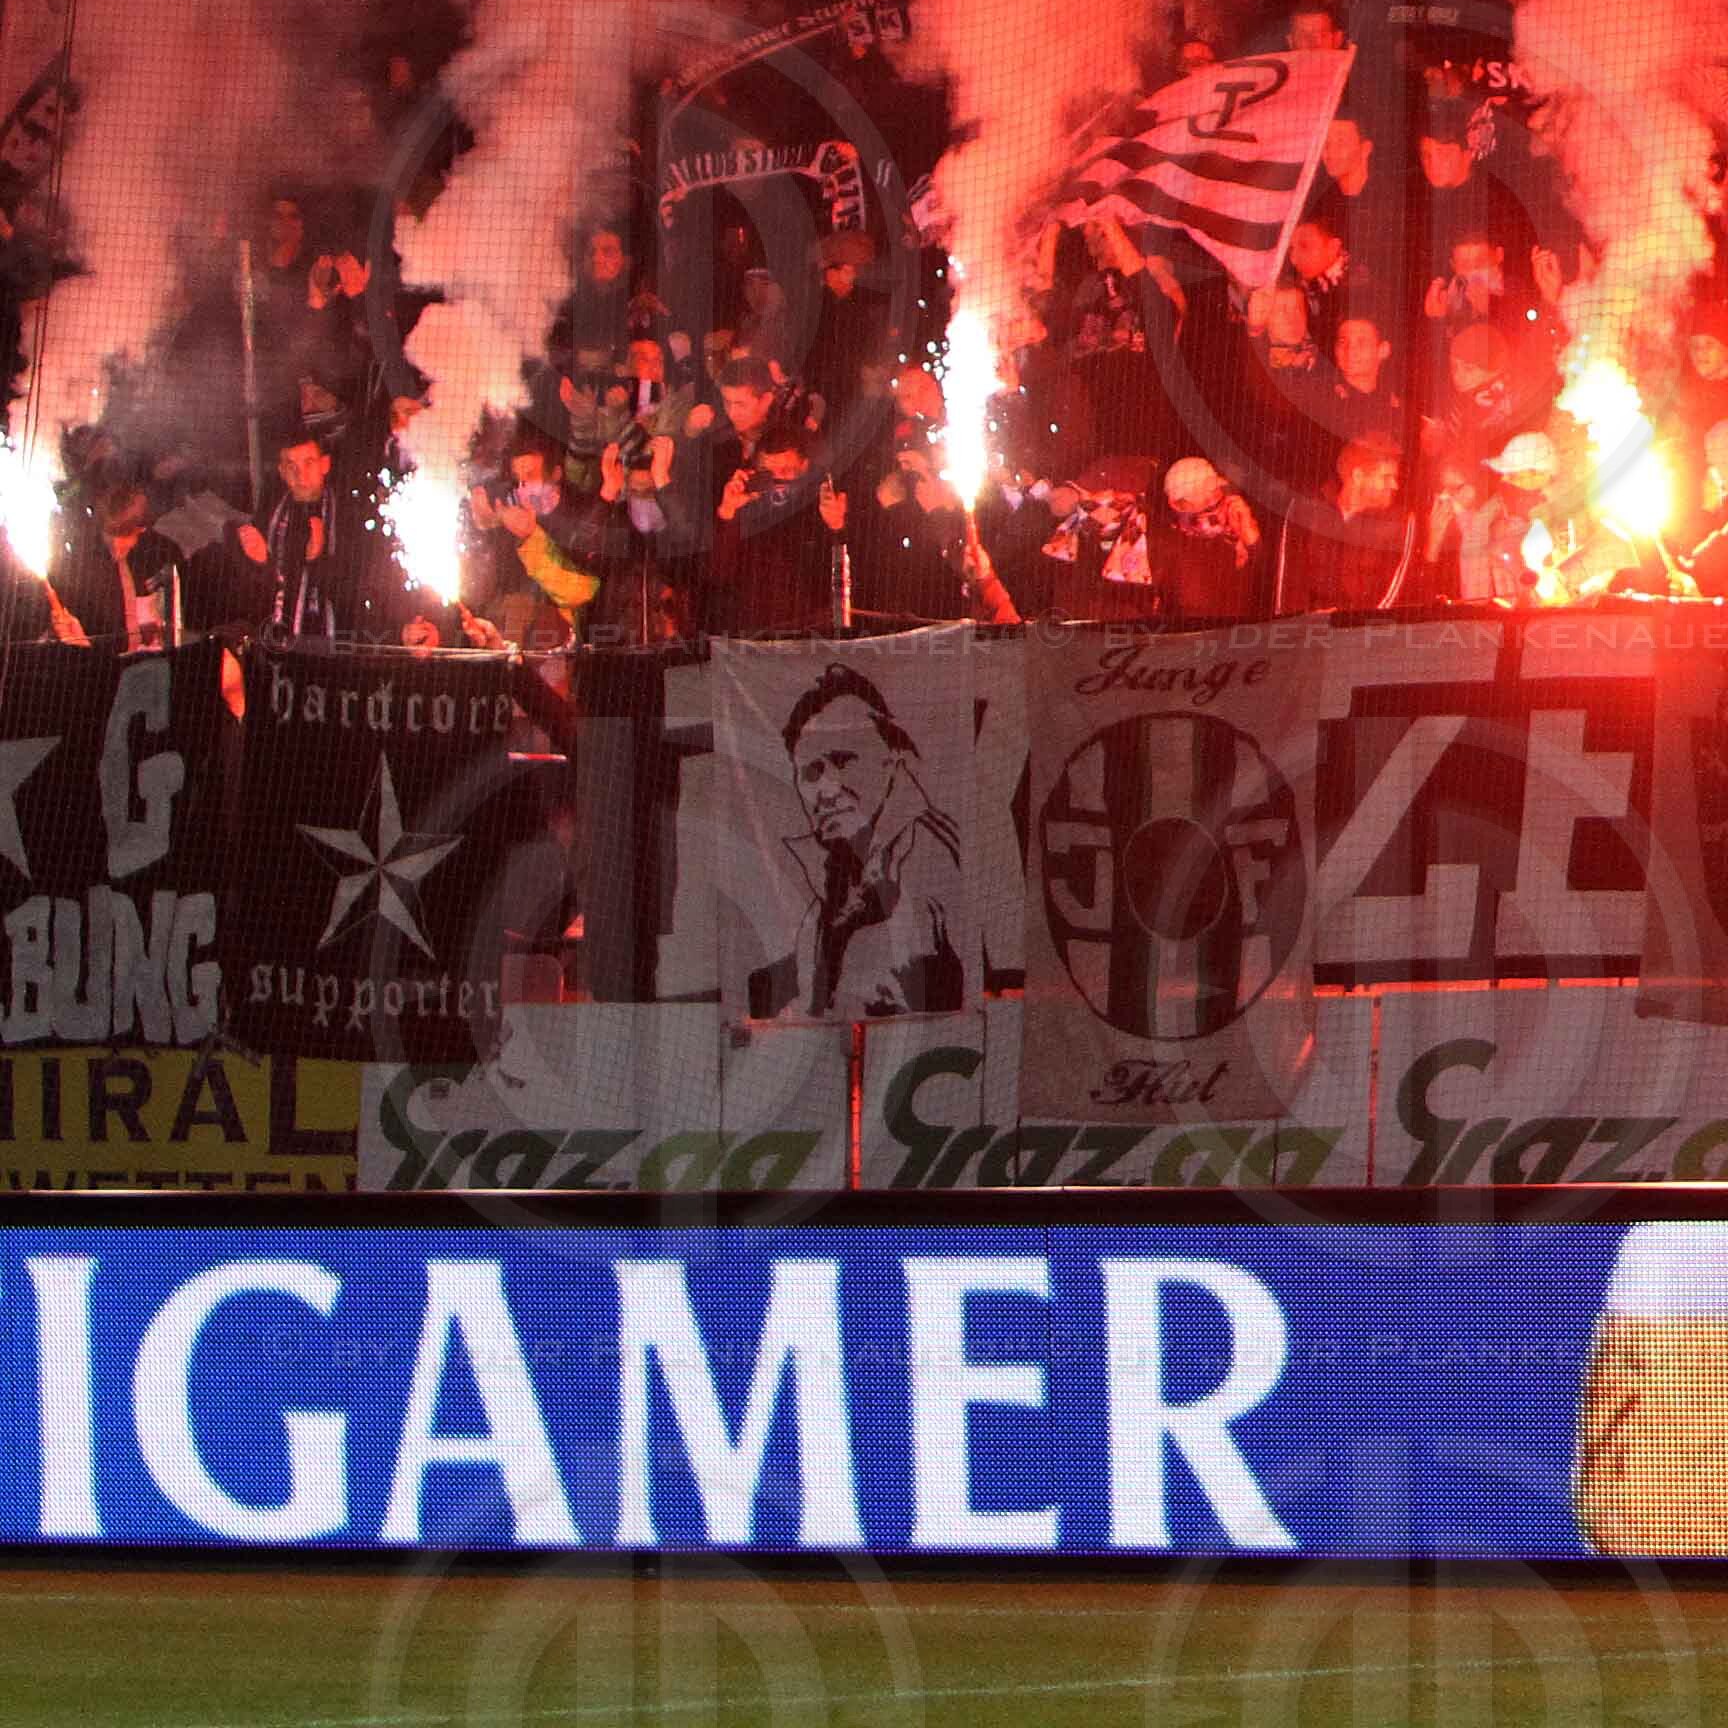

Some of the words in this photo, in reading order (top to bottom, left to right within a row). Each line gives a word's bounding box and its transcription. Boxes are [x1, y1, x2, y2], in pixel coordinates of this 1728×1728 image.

[268, 662, 514, 735] hardcore
[0, 884, 223, 1044] BUNG
[249, 964, 501, 1032] supporter
[0, 1040, 358, 1156] IRAL
[24, 1252, 1299, 1548] IGAMER
